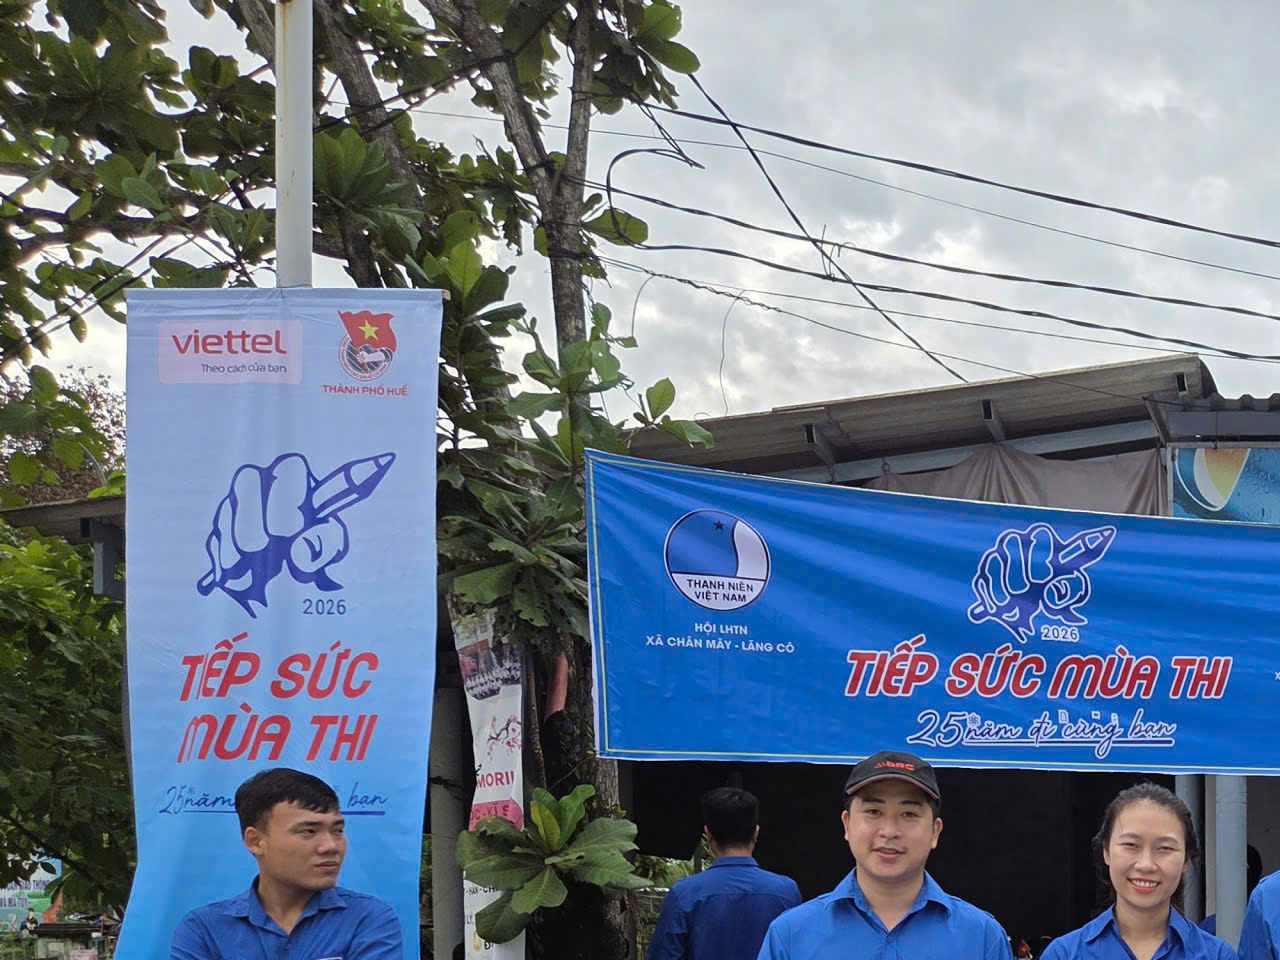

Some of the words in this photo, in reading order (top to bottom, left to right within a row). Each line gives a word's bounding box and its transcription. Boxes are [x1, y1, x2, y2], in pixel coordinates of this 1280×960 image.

[172, 328, 288, 355] viettel
[202, 364, 225, 374] Theo
[227, 362, 247, 374] cách
[248, 362, 266, 373] của
[268, 363, 287, 374] bạn
[323, 383, 360, 395] THÀNH
[362, 384, 384, 396] PHỐ
[387, 384, 408, 396] HUẾ
[686, 579, 724, 591] THANH
[728, 580, 754, 592] NIÊN
[694, 590, 719, 602] VIỆT
[722, 592, 746, 602] NAM
[303, 598, 346, 616] 2026
[694, 621, 716, 635] HỘI
[720, 624, 748, 635] LHTN
[1041, 625, 1080, 642] 2026
[646, 634, 664, 646] XÃ
[667, 636, 702, 648] CHÂN
[706, 638, 732, 650] MÂY
[742, 640, 773, 652] LĂNG
[776, 641, 795, 654] CÔ
[270, 640, 379, 699] SỨC
[845, 633, 938, 697] TIẾP
[945, 643, 1046, 698] SỨC
[1048, 645, 1160, 700] MÙA
[1168, 656, 1233, 700] THI
[177, 702, 291, 764] MÙA
[305, 714, 378, 762] THI
[907, 710, 966, 746] 25
[966, 720, 1020, 741] năm
[1028, 712, 1055, 747] đi
[1062, 718, 1120, 759] cùng
[1128, 708, 1177, 740] bạn
